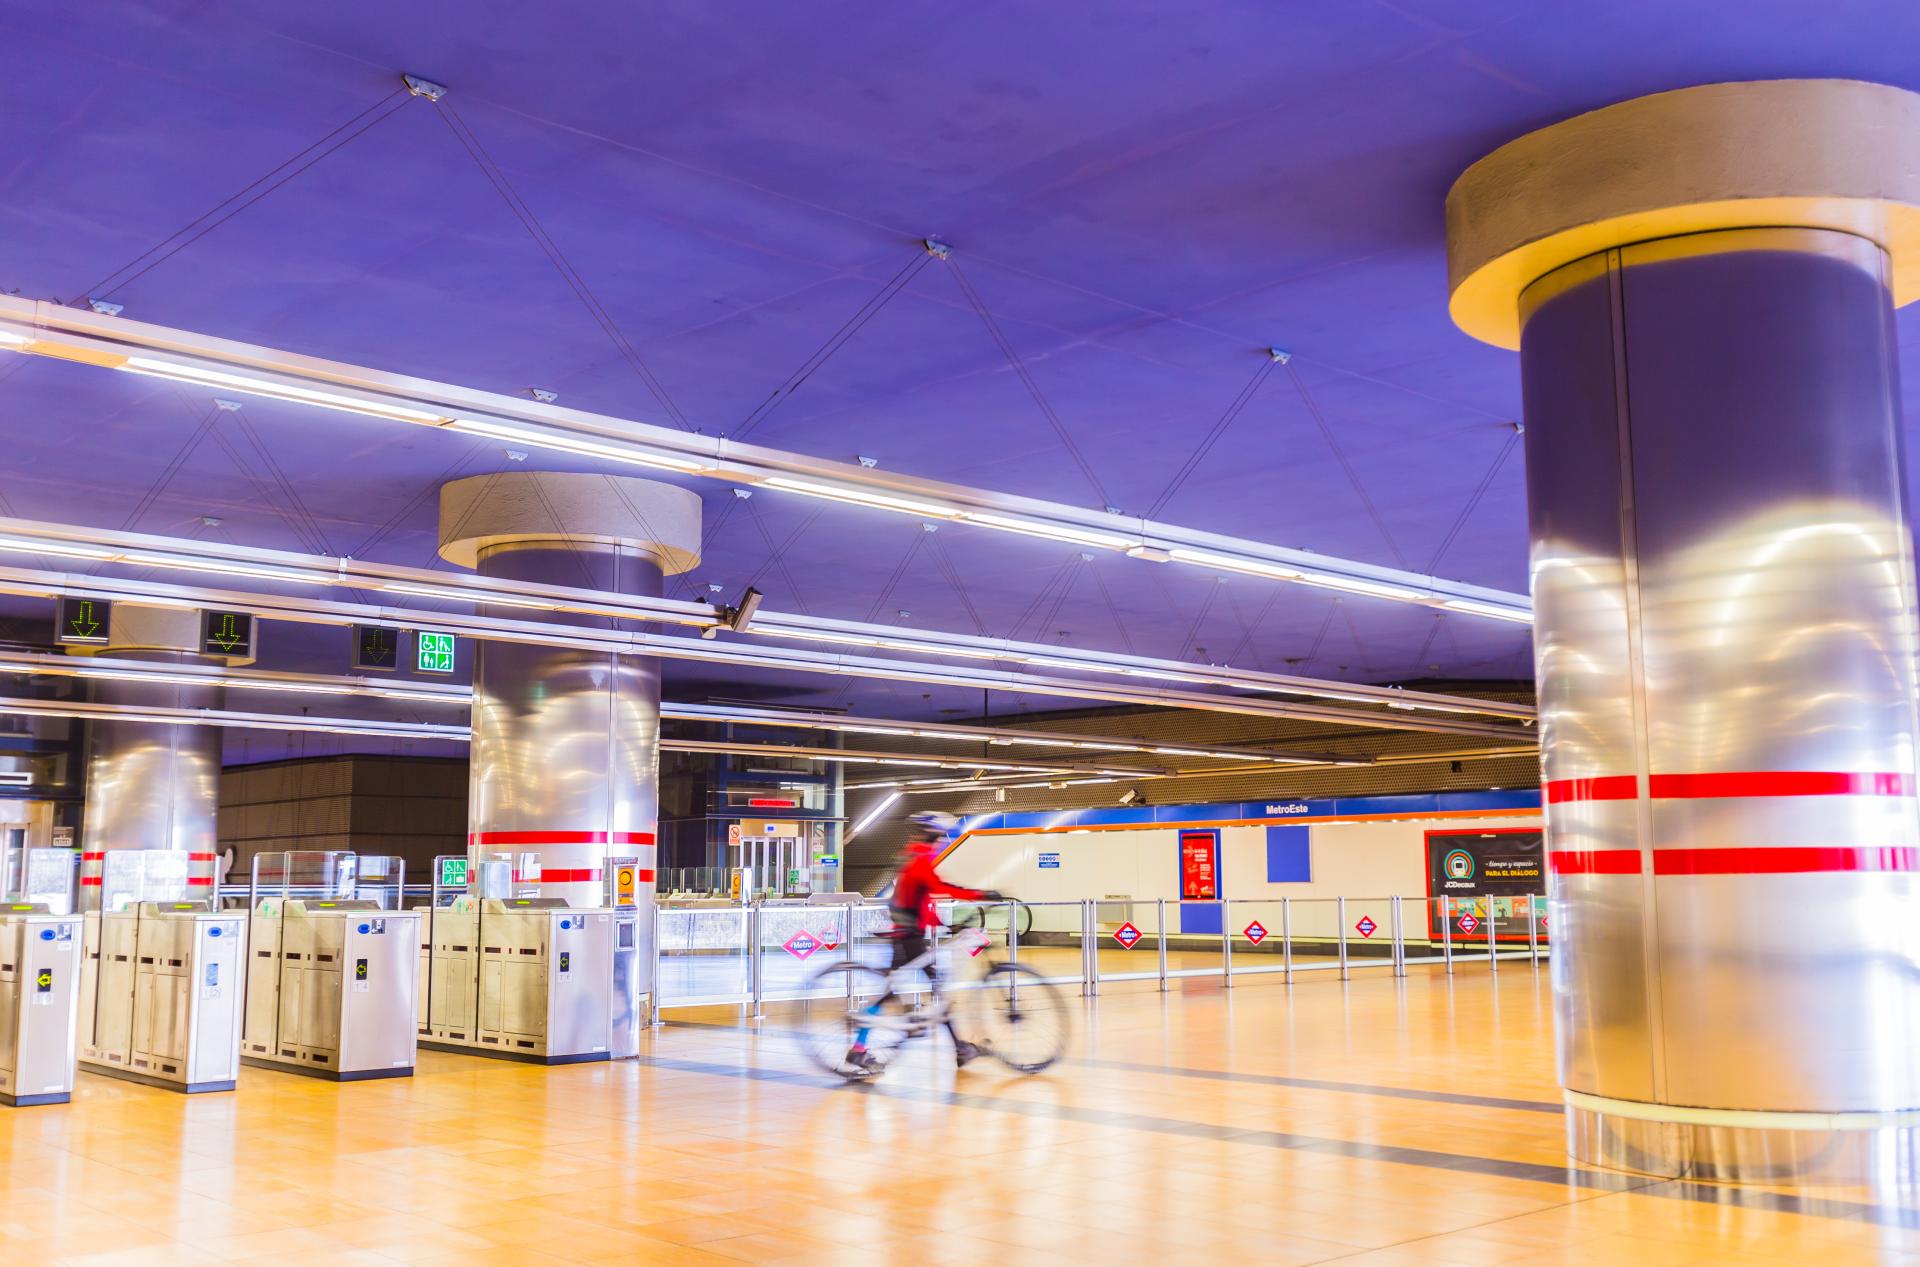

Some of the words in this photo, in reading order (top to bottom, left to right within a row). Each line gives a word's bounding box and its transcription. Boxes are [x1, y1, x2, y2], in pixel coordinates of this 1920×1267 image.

[1266, 804, 1308, 814] MetroEste
[1510, 868, 1539, 876] DIÁLOGO
[793, 941, 812, 949] Metro
